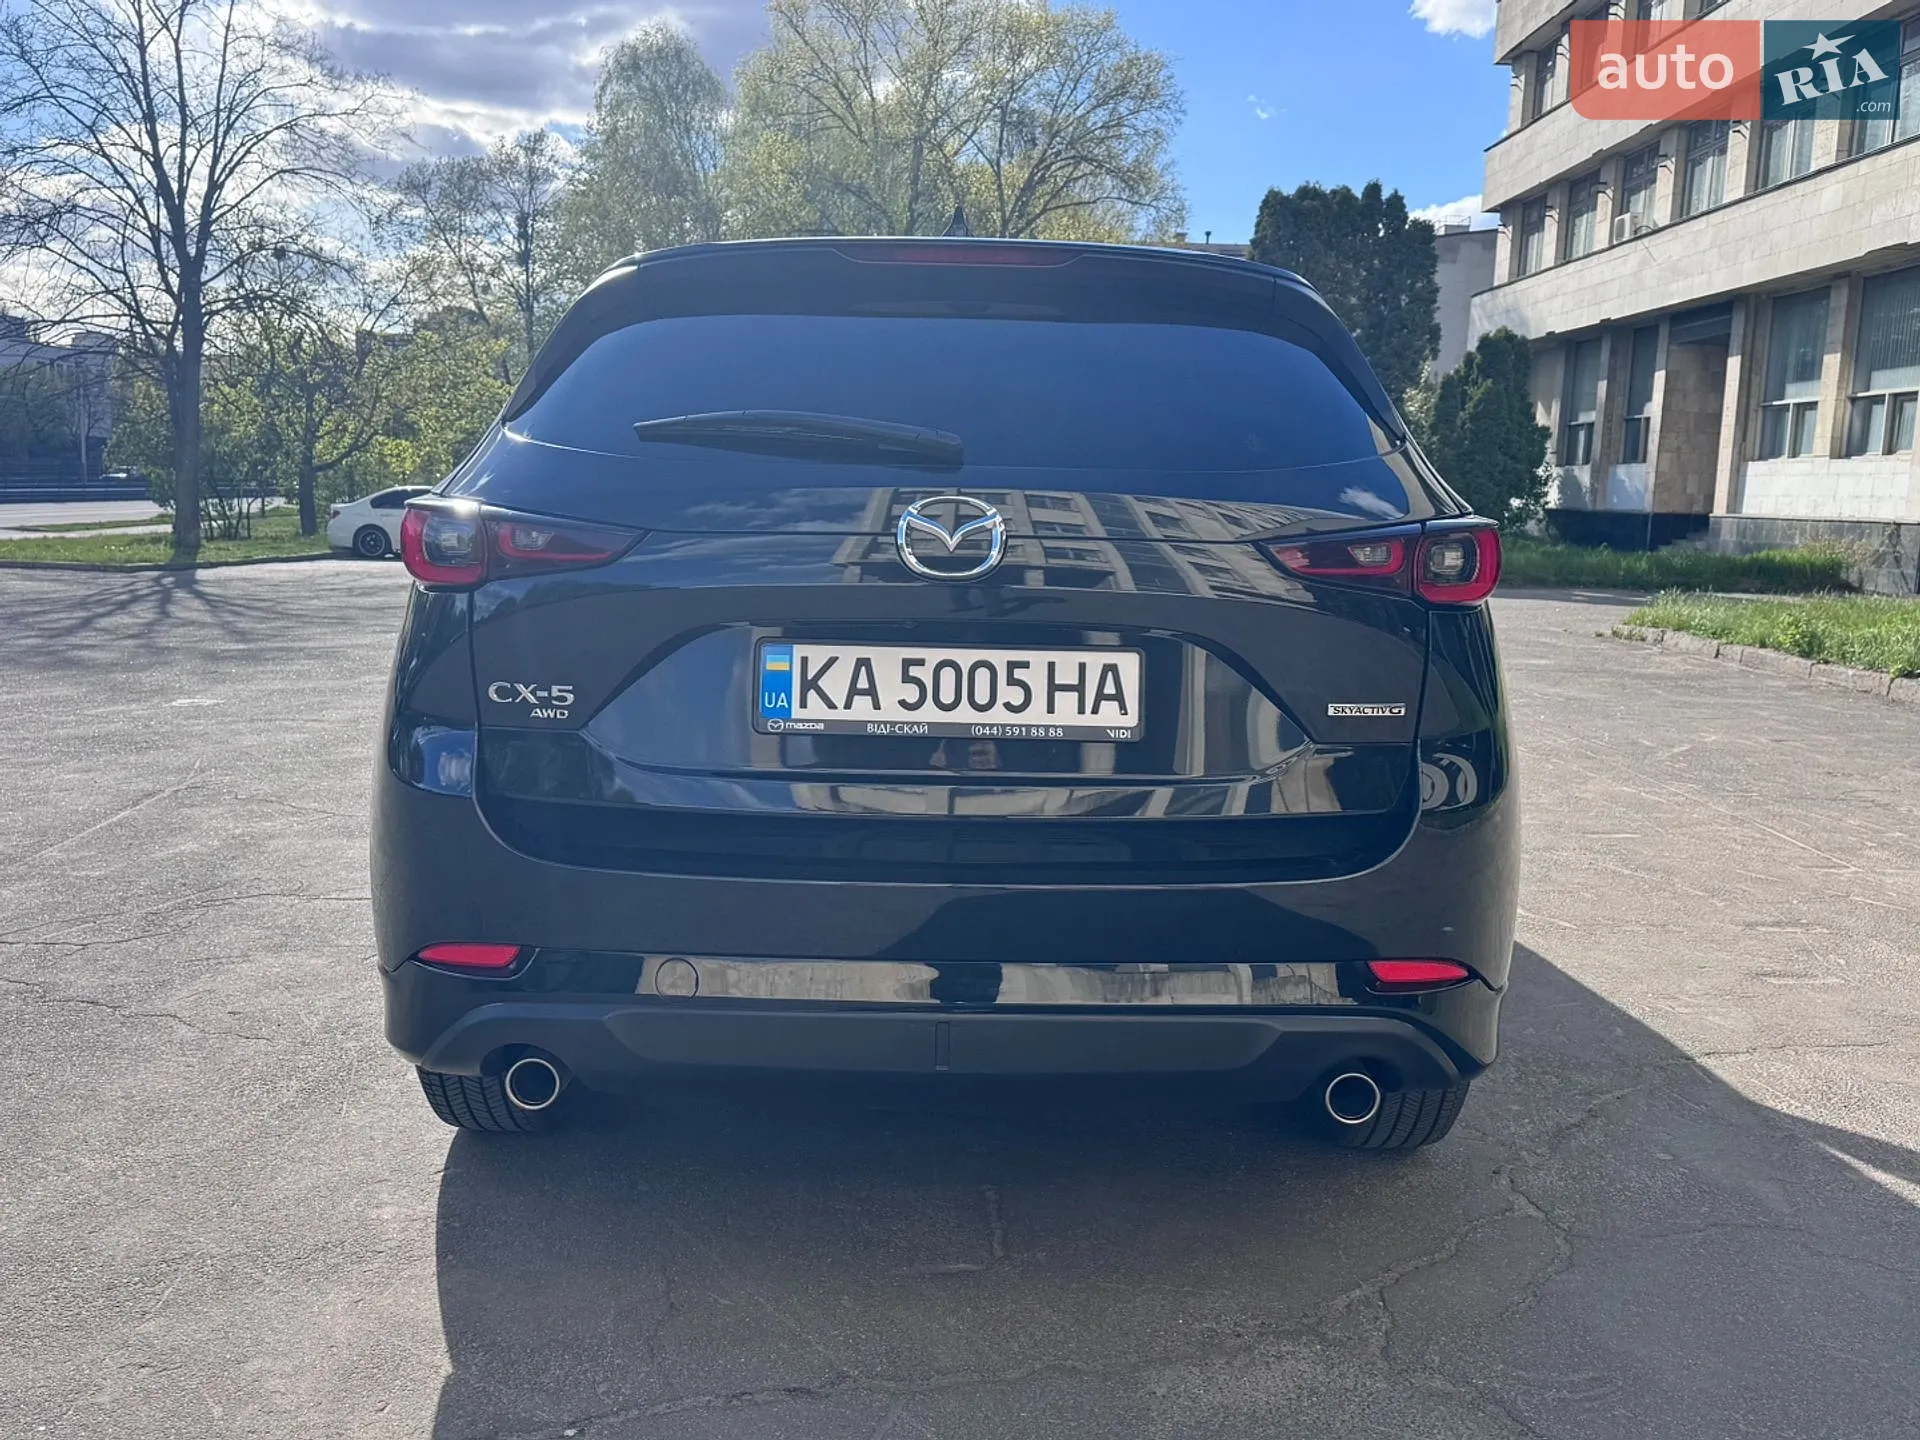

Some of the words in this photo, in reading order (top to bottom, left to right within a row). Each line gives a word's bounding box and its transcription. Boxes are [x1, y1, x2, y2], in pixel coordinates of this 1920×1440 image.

[799, 655, 882, 711] KA
[897, 657, 1033, 714] 5005
[488, 681, 575, 706] CX-5
[764, 692, 789, 708] UA
[530, 707, 569, 719] AWD
[785, 721, 825, 730] mazda
[971, 725, 1003, 738] (044)
[1005, 726, 1027, 737] 591
[1030, 727, 1046, 738] 88
[1048, 727, 1065, 738] 88
[1106, 728, 1132, 739] VIDI
